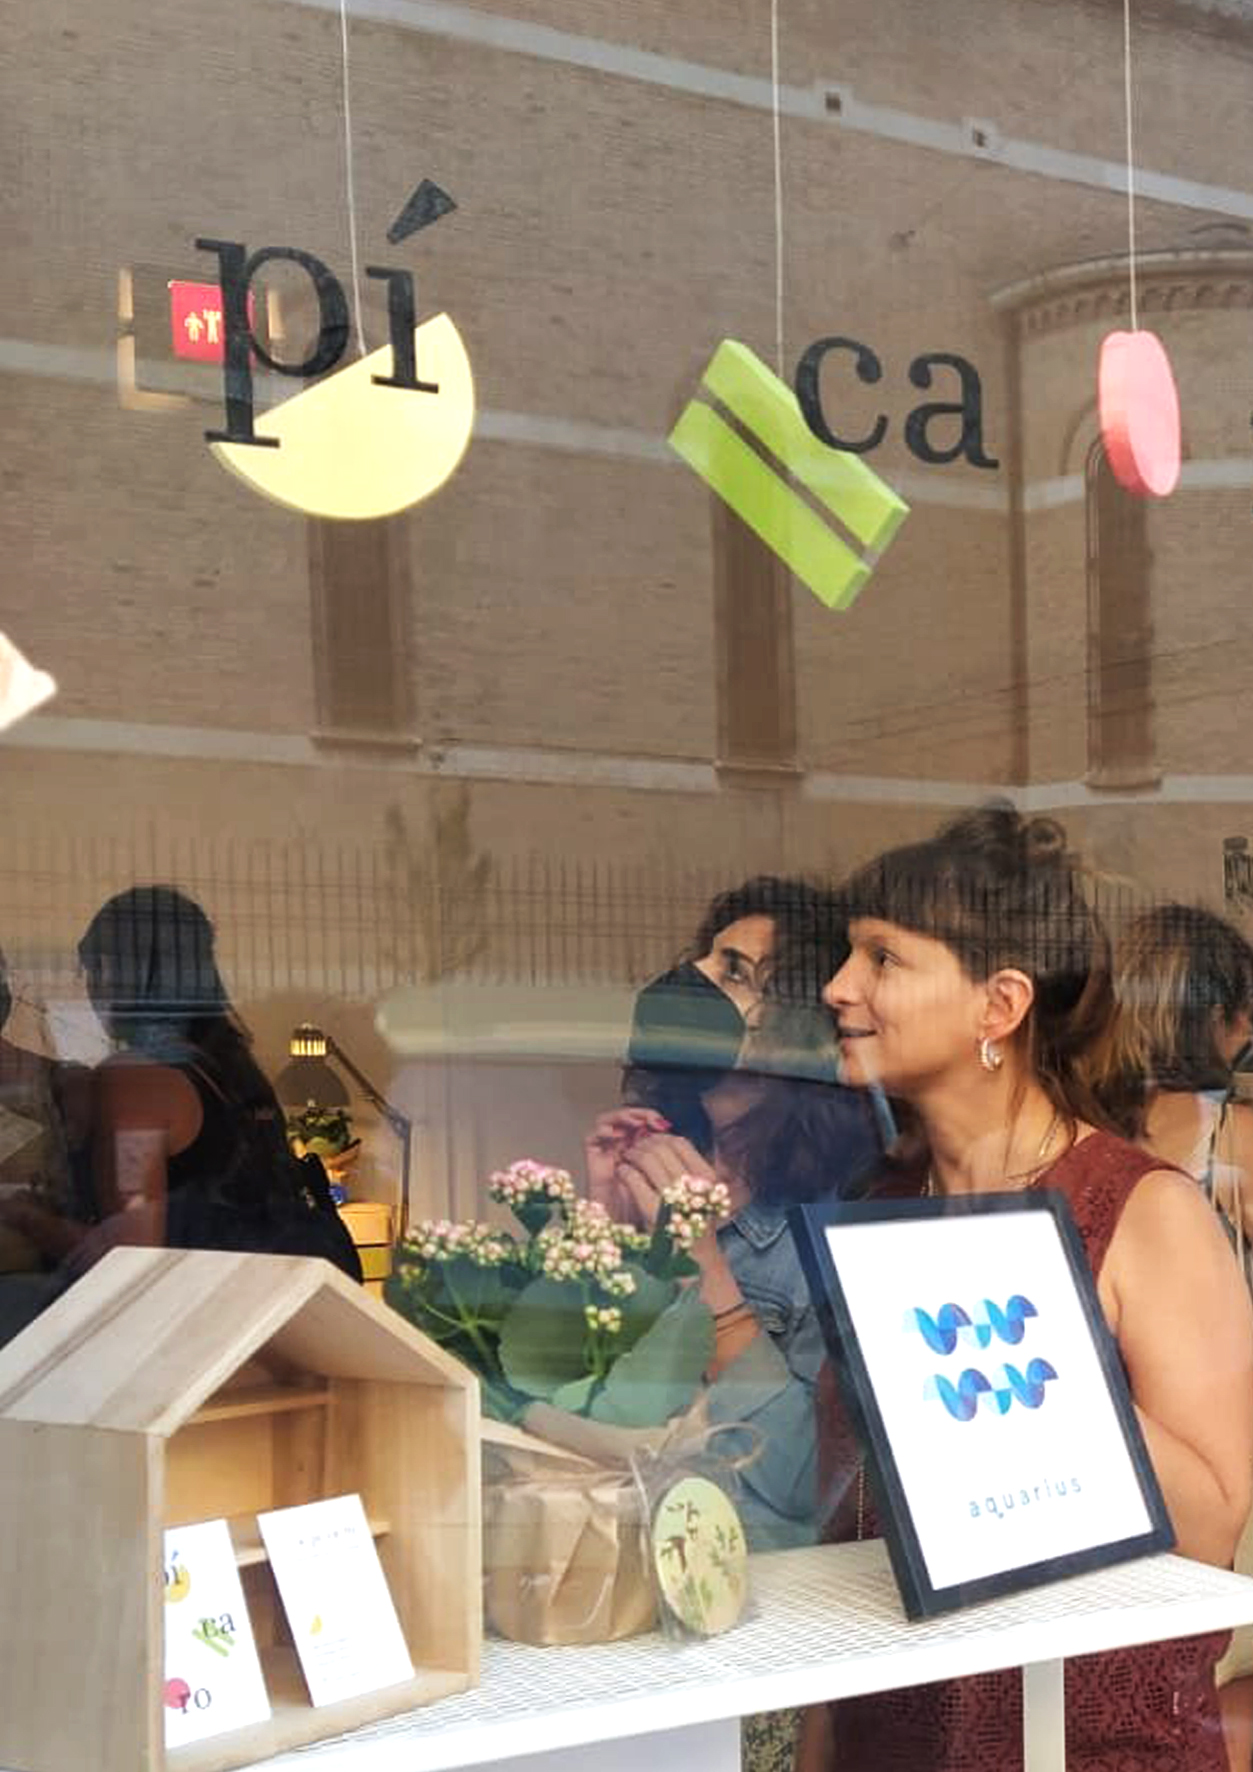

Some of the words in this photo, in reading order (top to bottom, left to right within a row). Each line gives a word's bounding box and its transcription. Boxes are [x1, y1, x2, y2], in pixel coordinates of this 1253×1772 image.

[194, 177, 458, 449] pí
[793, 336, 1000, 470] ca
[968, 1477, 1083, 1519] aquarius
